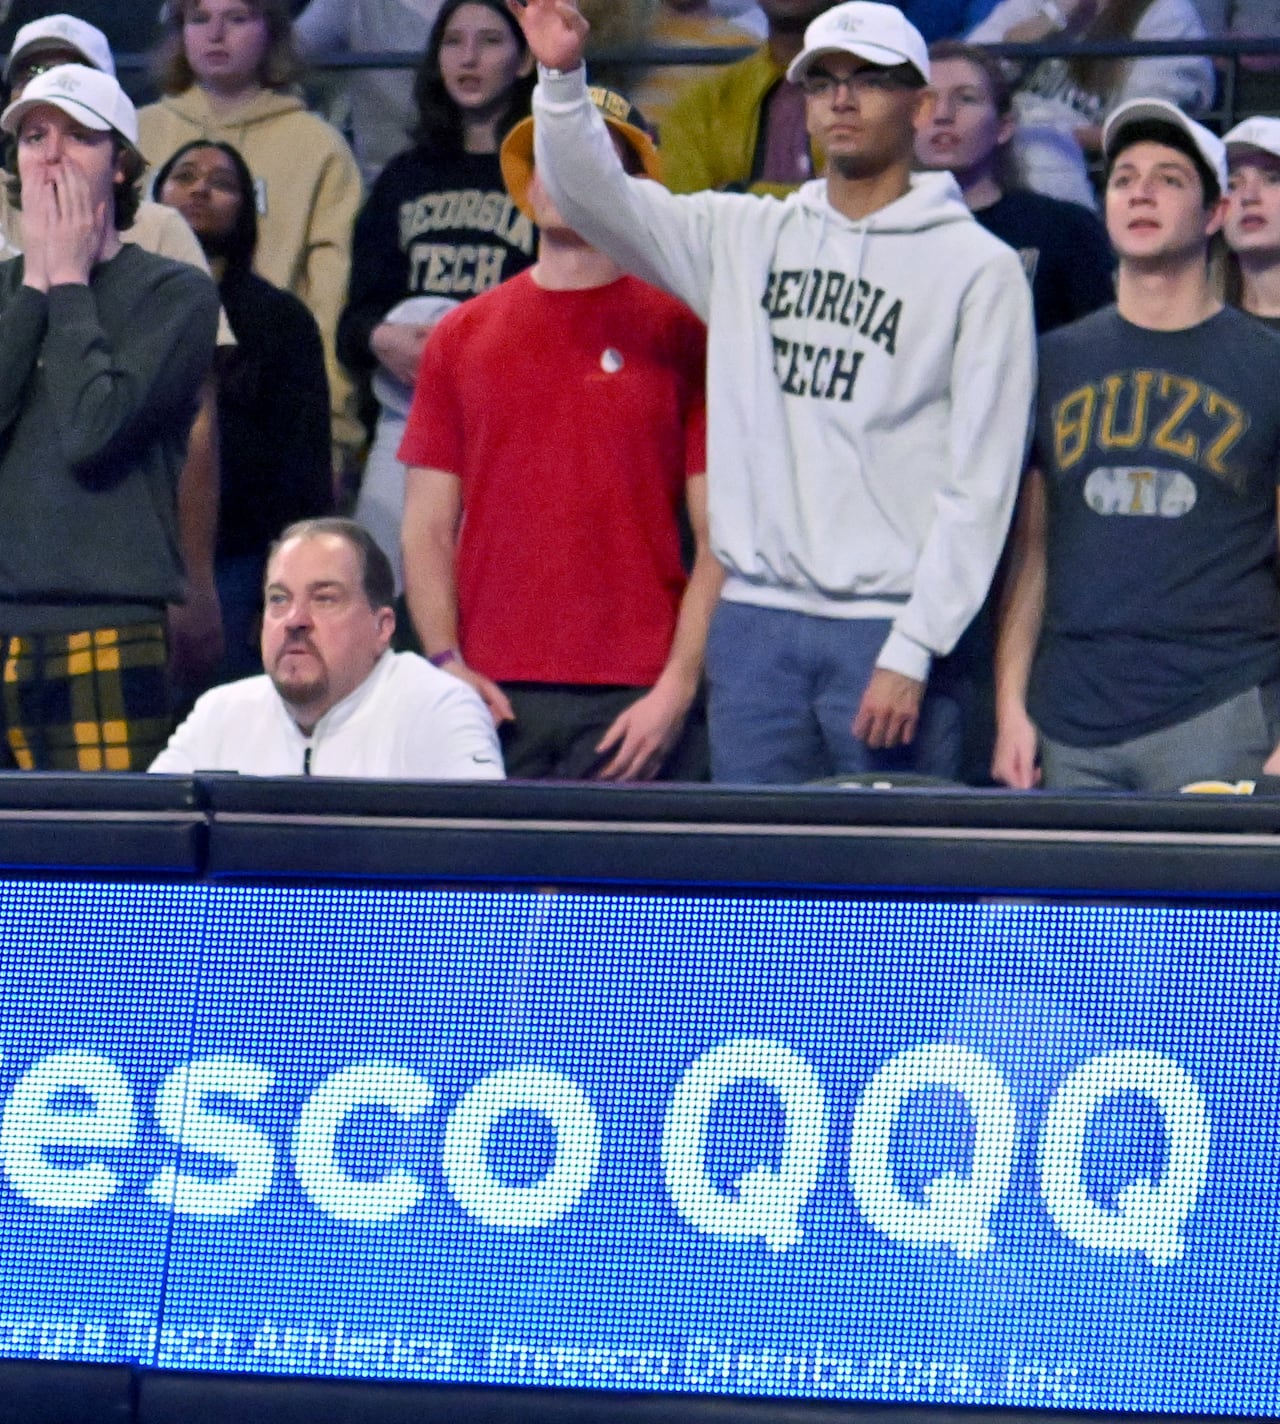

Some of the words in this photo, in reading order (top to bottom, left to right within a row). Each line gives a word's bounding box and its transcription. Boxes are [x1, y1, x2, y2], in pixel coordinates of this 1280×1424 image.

[1052, 369, 1251, 477] BUZZ
[659, 1035, 1214, 1268] QQQ
[126, 1311, 234, 1358] Tech
